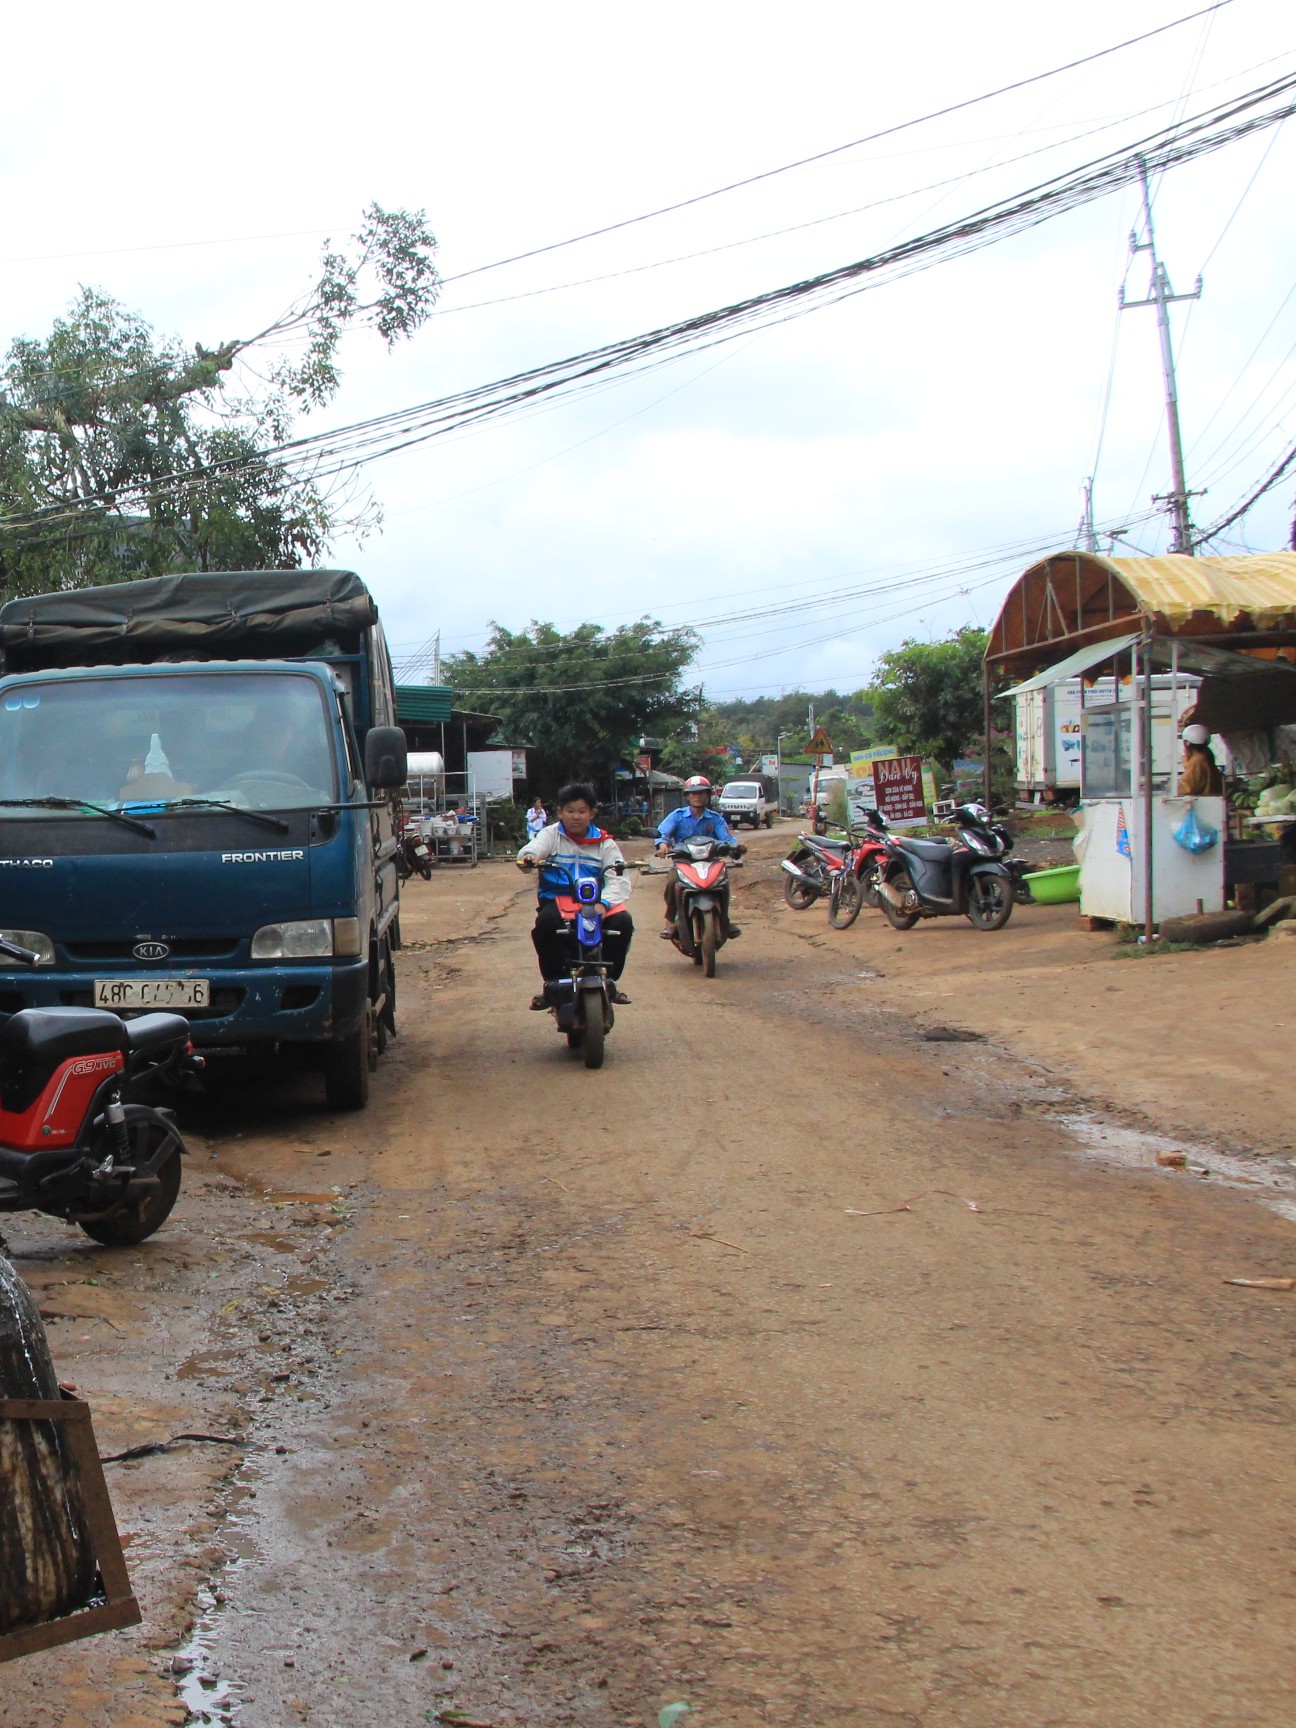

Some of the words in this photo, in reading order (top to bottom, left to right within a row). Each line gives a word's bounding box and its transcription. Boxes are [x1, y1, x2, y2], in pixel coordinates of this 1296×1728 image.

[0, 859, 54, 869] THACO
[221, 850, 304, 864] FRONTIER
[139, 946, 163, 956] KIA
[73, 1060, 96, 1075] G9
[96, 1059, 116, 1071] JVC
